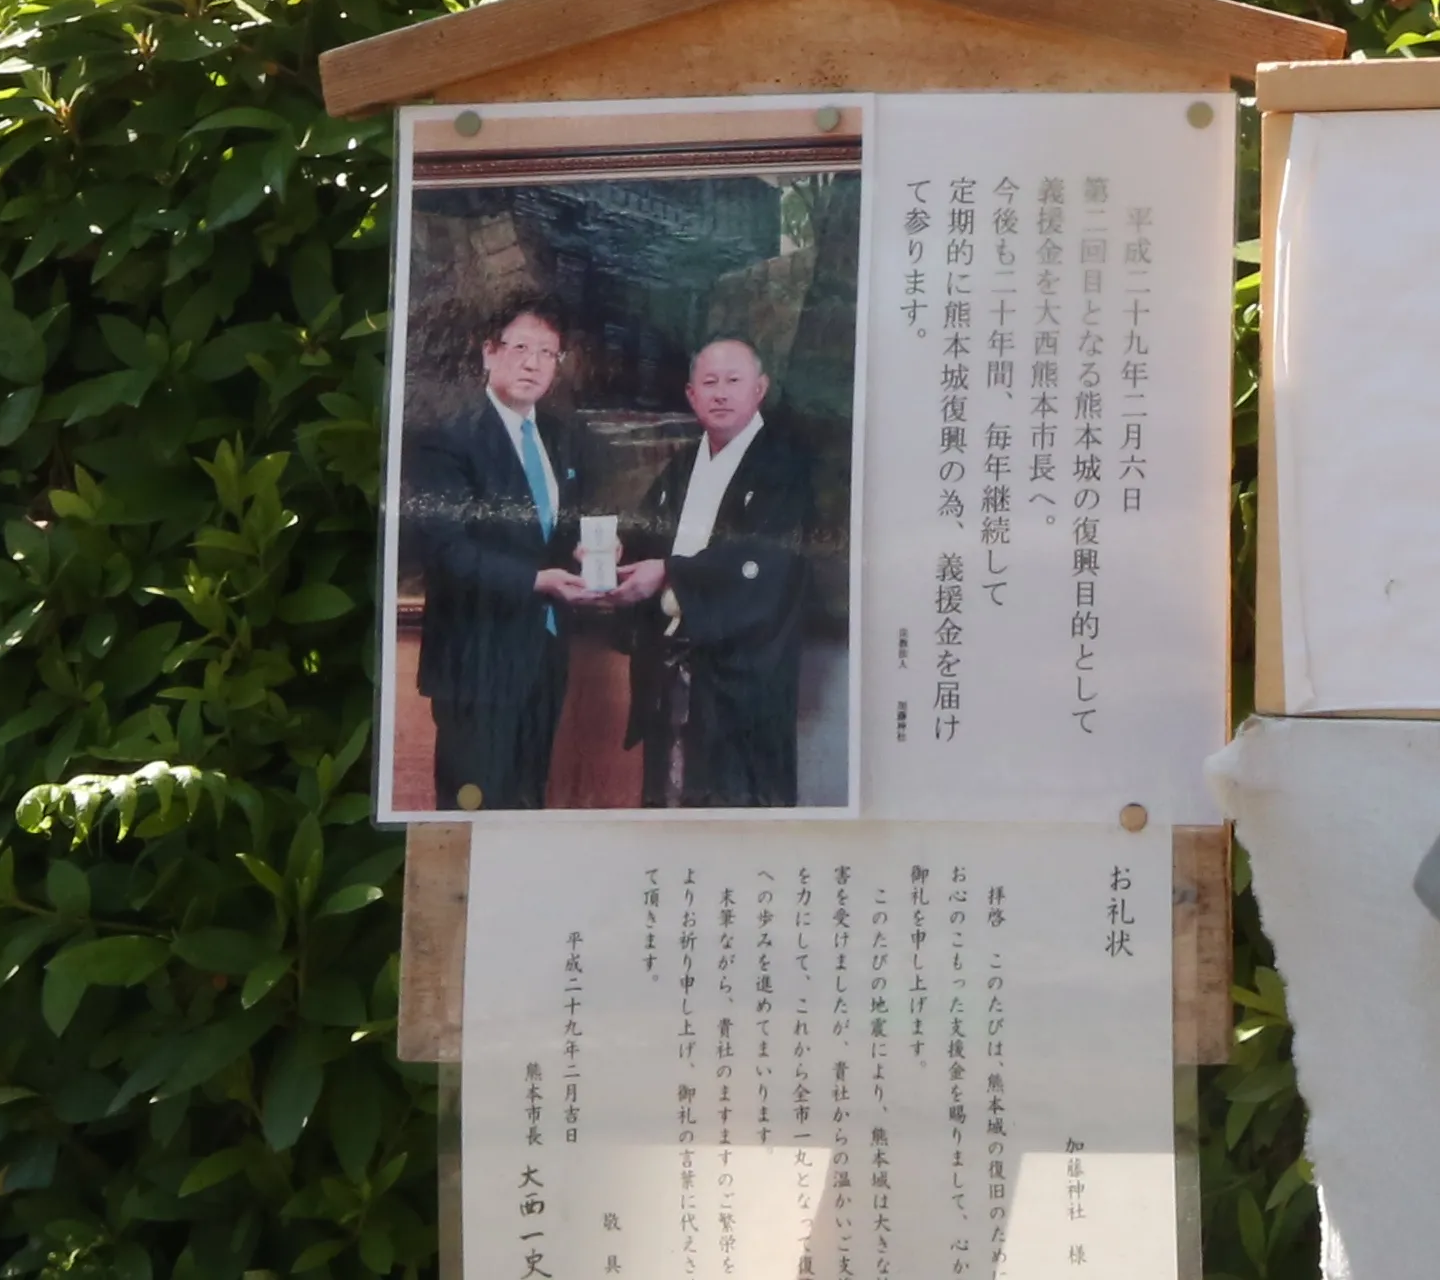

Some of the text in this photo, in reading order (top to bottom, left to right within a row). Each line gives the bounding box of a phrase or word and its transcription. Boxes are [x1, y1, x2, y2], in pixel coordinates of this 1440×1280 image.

[900, 179, 931, 339] て参ります。
[1028, 176, 1065, 526] 義援金を大西熊本市長へ。
[1118, 206, 1153, 513] 平成二十九年二月六日
[1070, 175, 1110, 735] 第二回目となる熊本城の復興目的として
[563, 931, 584, 1144] 平成二十九年二月吉日
[642, 867, 661, 983] て頂きます。
[909, 865, 930, 1070] 御礼を申し上げます。
[986, 886, 1007, 927] 拝啓
[1105, 865, 1135, 958] お礼状
[517, 1061, 553, 1280] 熊本市長 大西一史
[678, 867, 700, 1280] よりお祈り申し上げ、御礼の言葉に代えさ
[792, 867, 814, 1280] を力にして、これから全市一丸となって復
[831, 865, 854, 1280] 害を受けましたが、貴社からの温かいご支
[870, 888, 891, 1280] このたびの地震により、熊本城は大きな
[947, 866, 969, 1280] お心のこもった支援金を賜りまして、心か
[1065, 1137, 1087, 1265] 加藤神社 様
